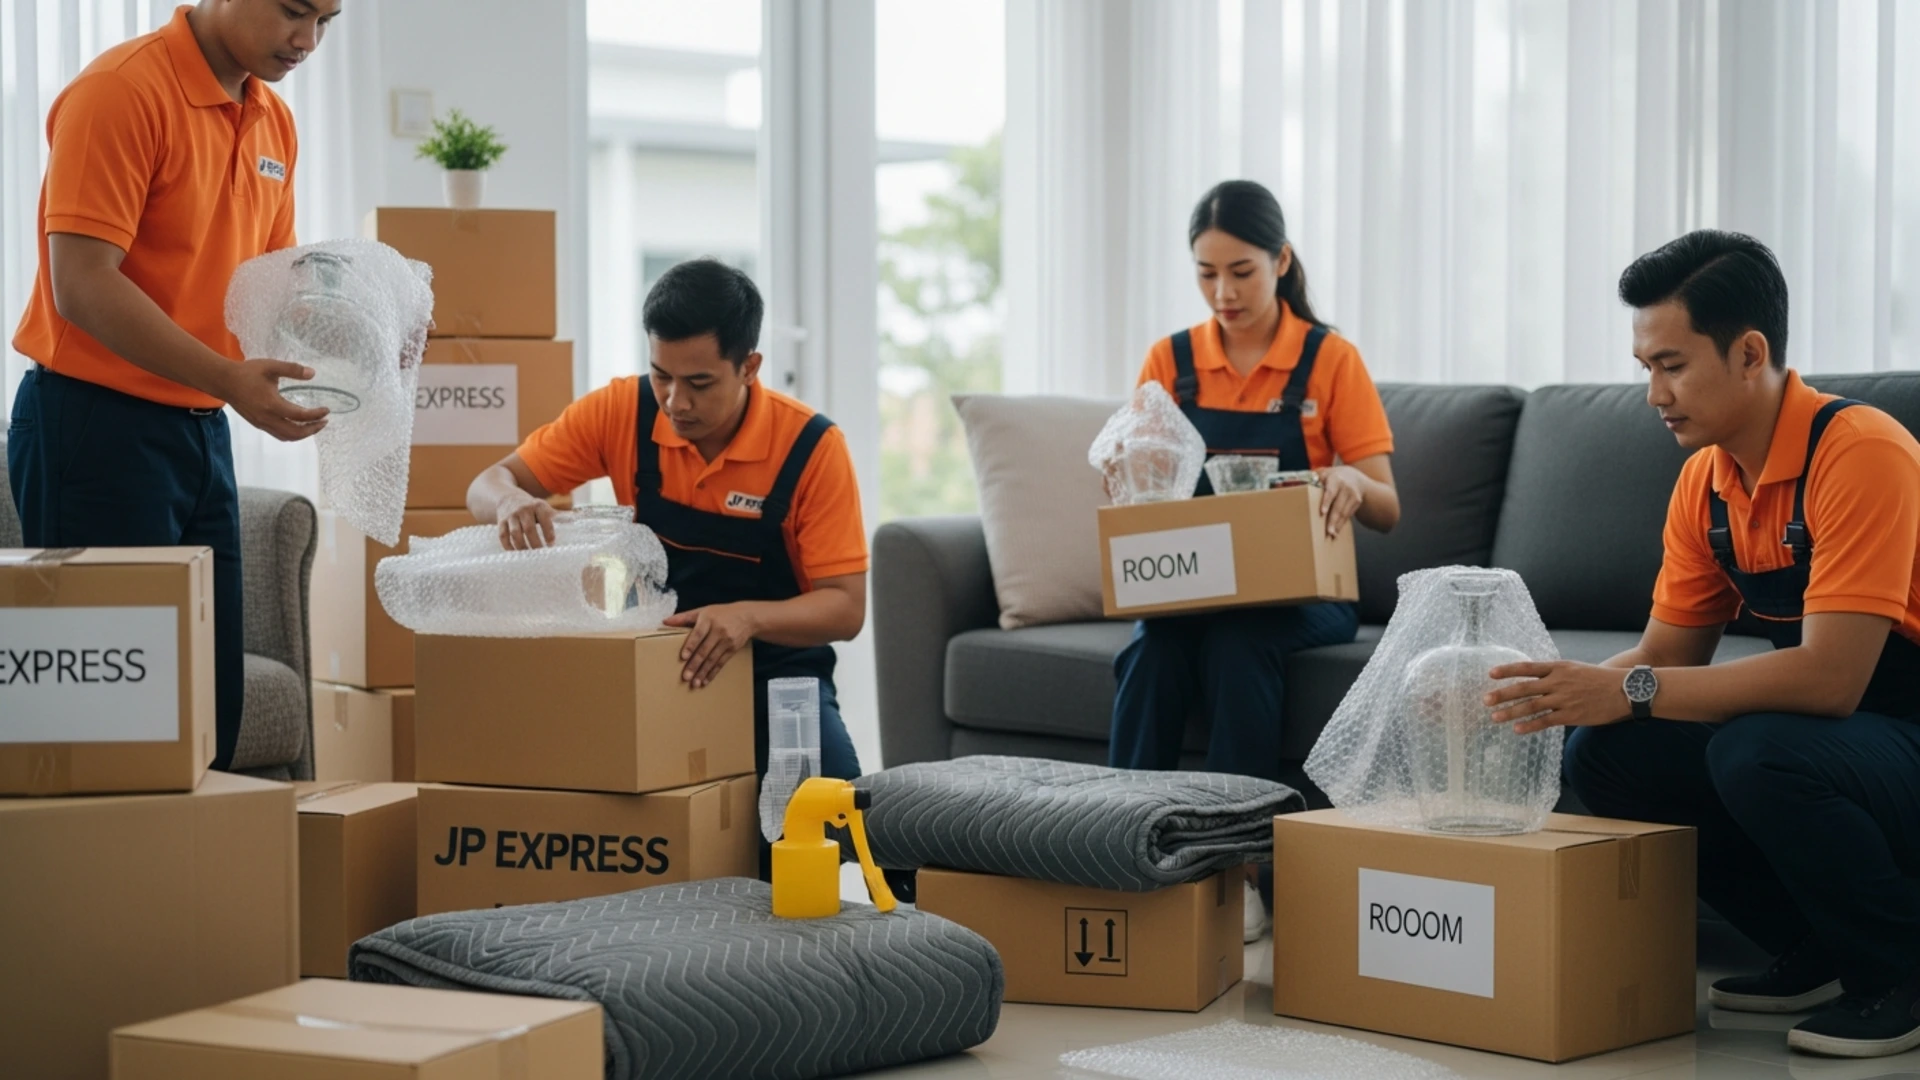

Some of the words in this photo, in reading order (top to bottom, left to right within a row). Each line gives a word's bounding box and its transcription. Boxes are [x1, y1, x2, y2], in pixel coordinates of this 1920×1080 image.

[415, 386, 505, 409] EXPRESS
[1122, 551, 1199, 583] ROOM
[434, 826, 486, 866] JP
[495, 830, 670, 875] EXPRESS
[1369, 902, 1463, 945] ROOOM
